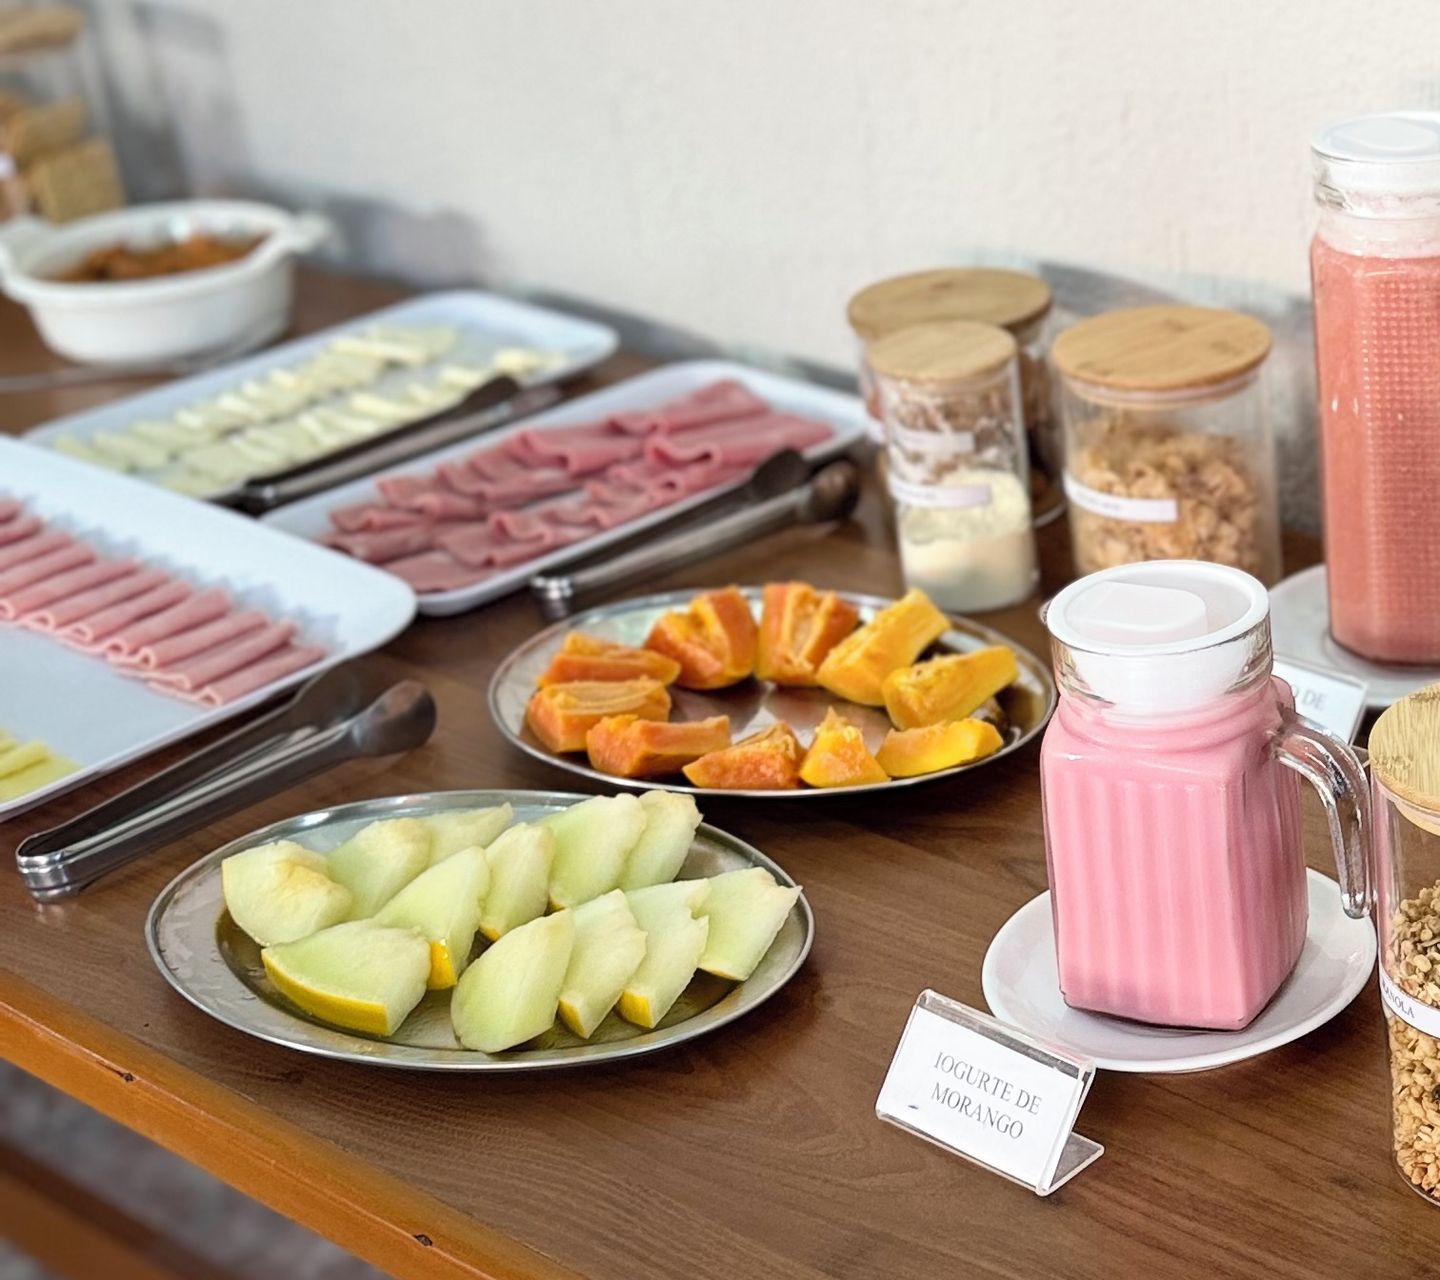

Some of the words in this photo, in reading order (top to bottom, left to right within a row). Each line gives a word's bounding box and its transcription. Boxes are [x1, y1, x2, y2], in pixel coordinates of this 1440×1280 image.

[930, 1081, 1024, 1140] MORANGO
[933, 1051, 1014, 1103] IOGURTE
[1014, 1088, 1043, 1116] DE
